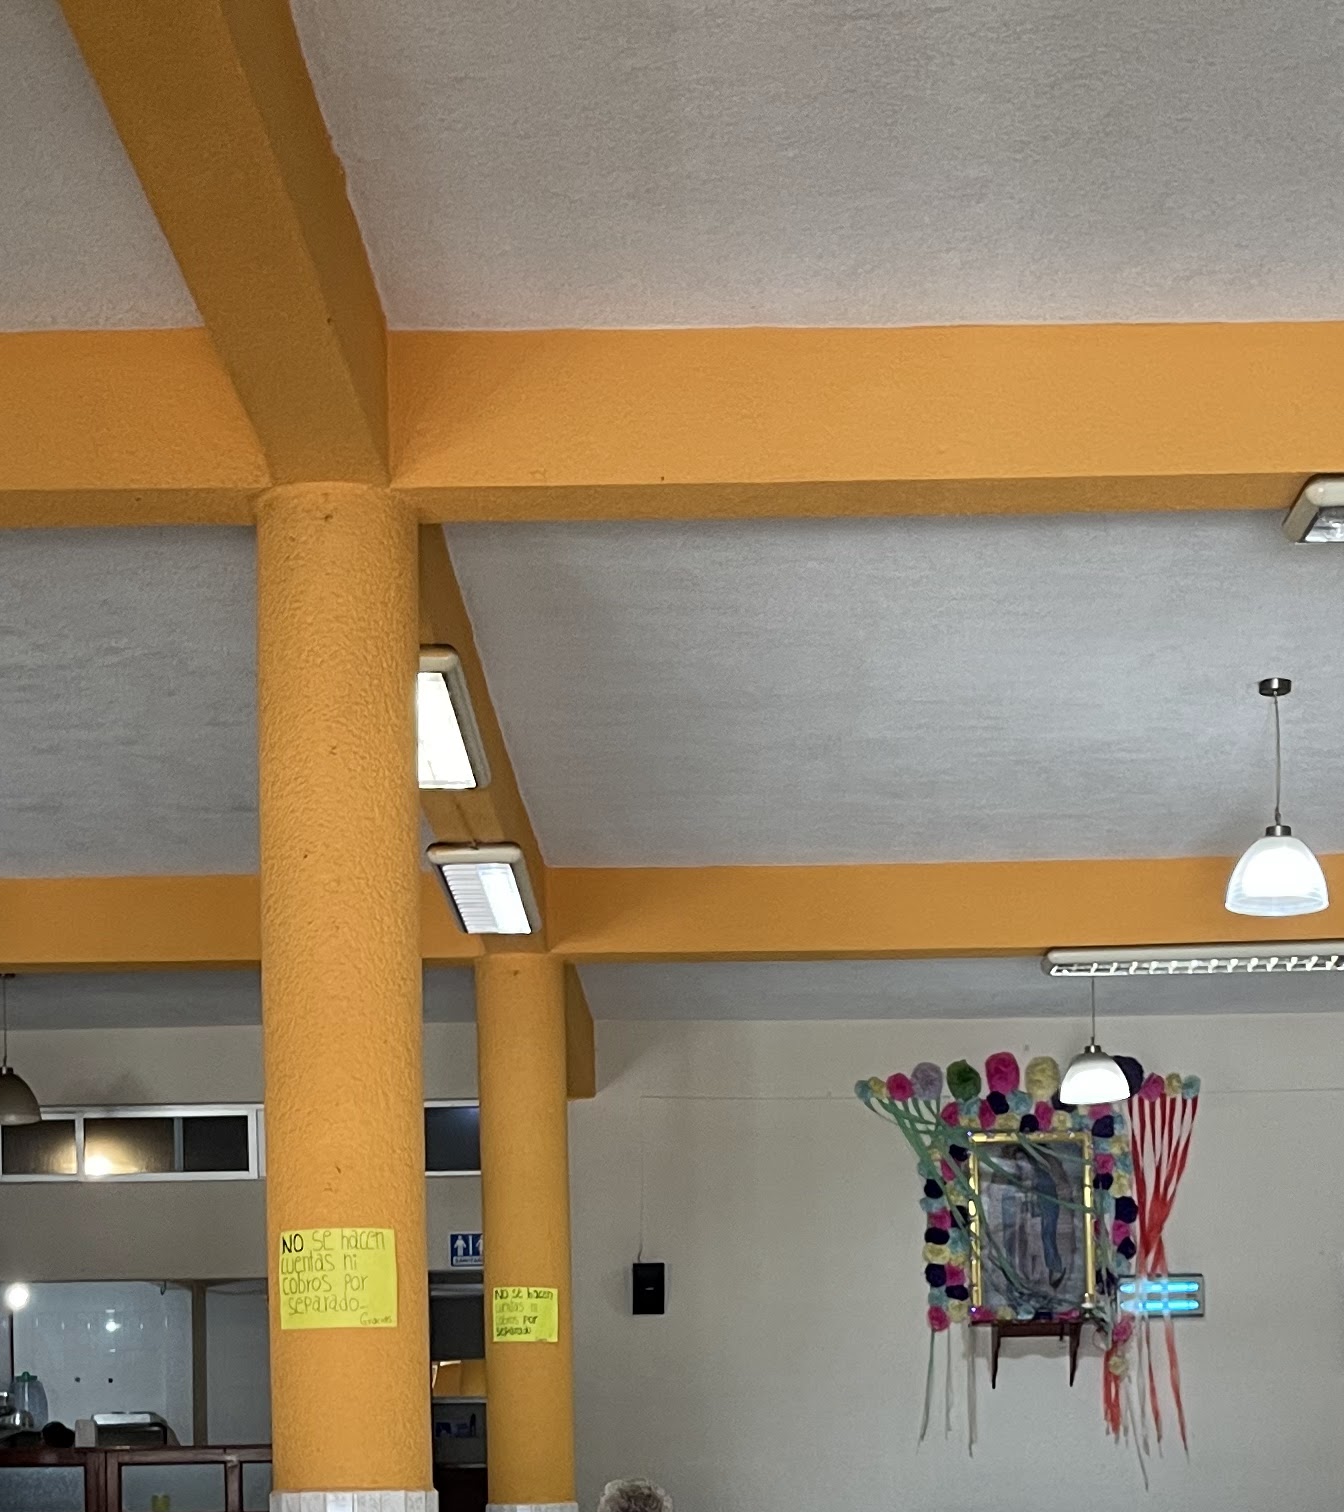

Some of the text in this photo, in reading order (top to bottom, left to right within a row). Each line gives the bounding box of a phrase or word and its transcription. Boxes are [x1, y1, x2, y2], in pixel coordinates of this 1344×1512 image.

[282, 1233, 304, 1254] NO
[341, 1228, 385, 1250] hacen
[281, 1251, 357, 1274] cuentas ni
[282, 1272, 368, 1295] cobros por
[494, 1289, 509, 1300] NO
